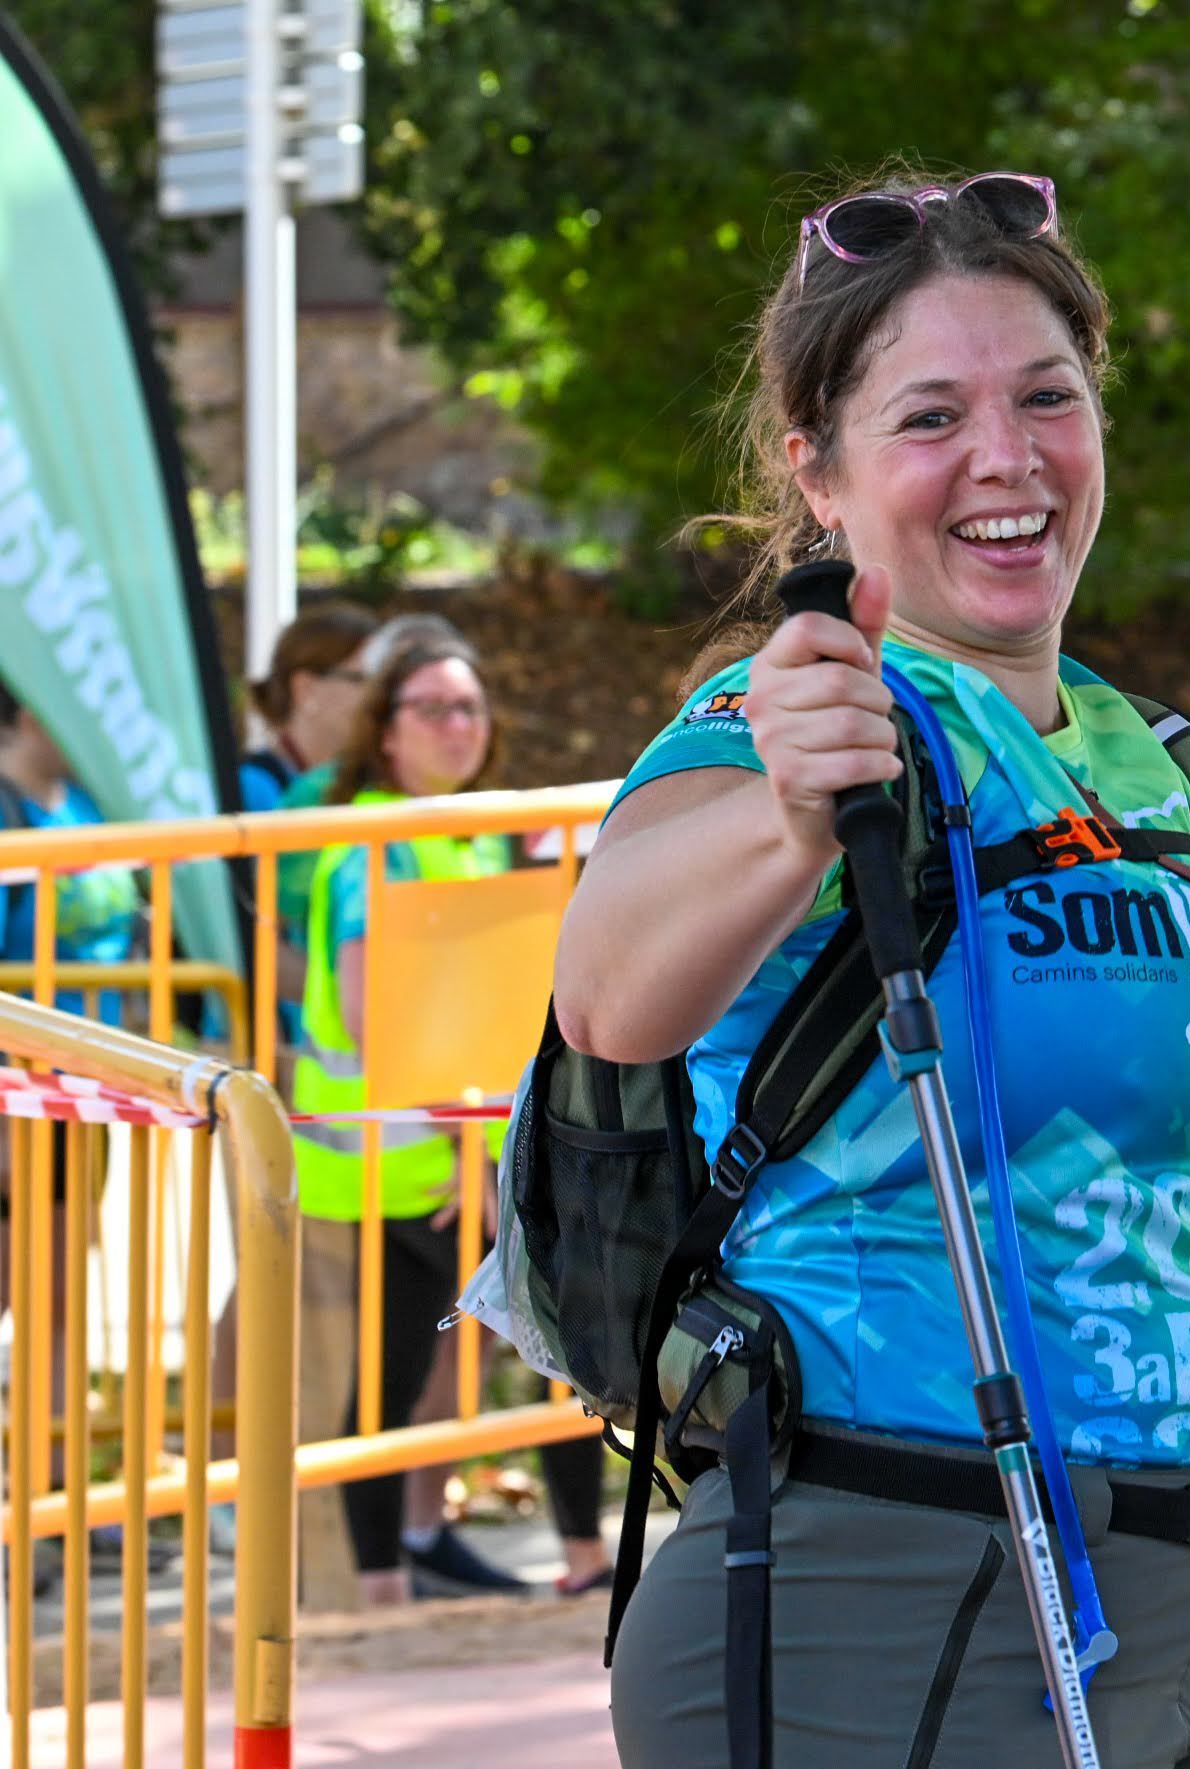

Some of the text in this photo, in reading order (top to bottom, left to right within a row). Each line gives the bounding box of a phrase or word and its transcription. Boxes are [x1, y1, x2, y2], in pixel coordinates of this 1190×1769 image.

[1012, 962, 1178, 984] Camins solidaris
[1057, 1647, 1098, 1769] Diamon
